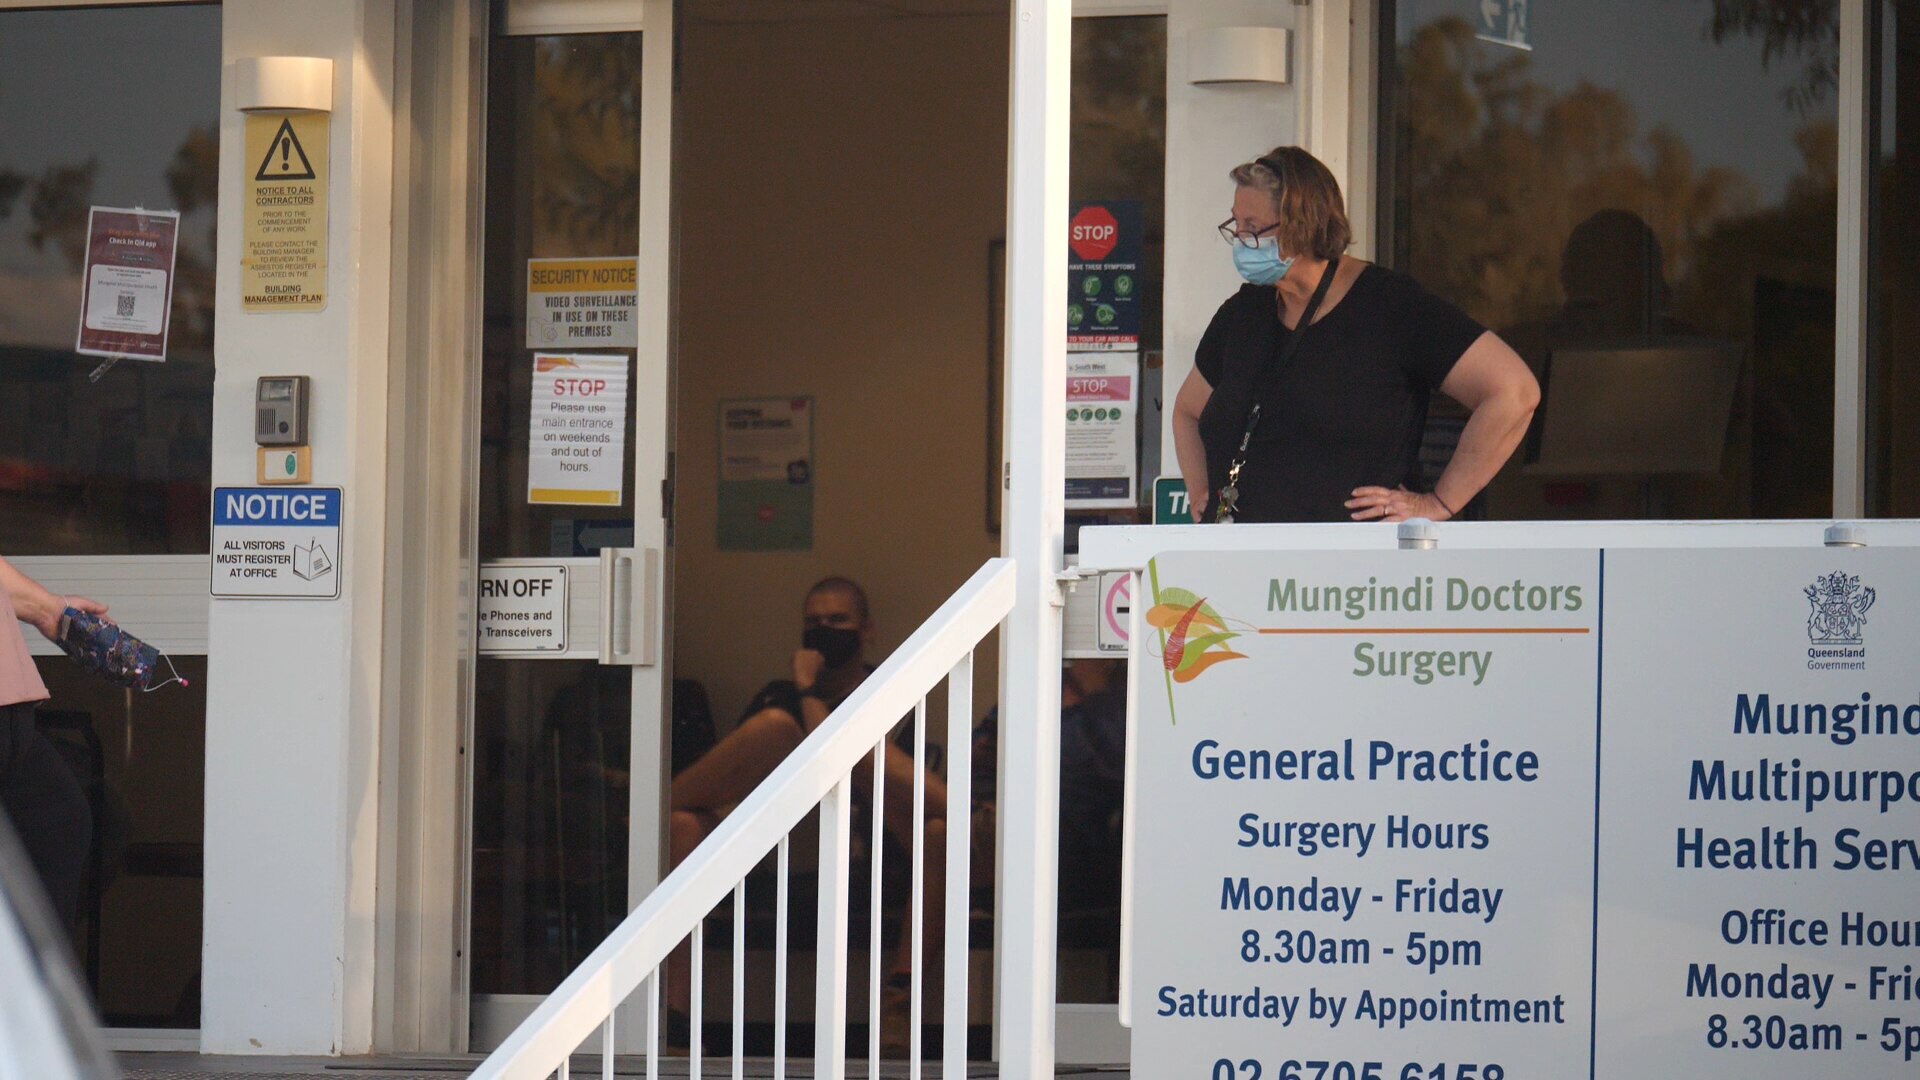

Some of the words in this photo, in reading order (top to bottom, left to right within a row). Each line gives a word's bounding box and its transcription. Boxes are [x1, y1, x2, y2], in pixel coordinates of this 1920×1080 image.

[256, 187, 285, 196] NOTICE
[287, 187, 297, 195] TO
[299, 186, 314, 194] ALL
[256, 196, 314, 205] CONTRACTORS
[257, 218, 311, 226] COMMENCEMENT
[1073, 225, 1114, 240] STOP
[109, 236, 127, 246] Check
[1069, 263, 1083, 271] HAVE
[1085, 263, 1103, 271] THESE
[1103, 263, 1136, 271] SYMPTOMS
[532, 269, 589, 285] SECURITY
[592, 267, 636, 283] NOTICE
[264, 285, 302, 293] BUILDING
[244, 294, 299, 303] MANAGEMENT
[301, 294, 322, 303] PLAN
[545, 296, 570, 308] VIDEO
[573, 295, 637, 307] SURVEILLANCE
[552, 311, 562, 323] IN
[565, 311, 582, 322] USE
[585, 310, 598, 322] ON
[601, 310, 628, 321] THESE
[568, 325, 612, 337] PREMISES
[553, 378, 607, 396] STOP
[1072, 379, 1108, 393] STOP
[550, 402, 585, 413] Please
[588, 404, 606, 413] use
[542, 417, 567, 428] main
[569, 418, 614, 429] entrance
[543, 433, 556, 442] on
[559, 432, 610, 443] weekends
[551, 447, 570, 457] and
[573, 448, 589, 457] out
[592, 447, 603, 457] of
[560, 460, 592, 472] hours.
[226, 494, 326, 520] NOTICE
[223, 540, 241, 550] ALL
[243, 540, 285, 550] VISITORS
[216, 554, 242, 564] MUST
[244, 554, 291, 564] REGISTER
[229, 568, 242, 578] AT
[243, 568, 277, 578] OFFICE
[513, 579, 553, 597] OFF
[1266, 576, 1433, 620] Mungindi
[1446, 578, 1583, 612] Doctors
[490, 610, 530, 621] Phones
[533, 610, 552, 620] and
[486, 627, 553, 638] Transceivers
[1807, 647, 1865, 659] Queensland
[1352, 642, 1493, 686] Surgery
[1807, 660, 1865, 670] Government
[1191, 738, 1354, 781] General
[1367, 739, 1540, 782] Practice
[1237, 812, 1376, 858] Surgery
[1386, 815, 1490, 850] Hours
[1676, 825, 1817, 870] Health
[1220, 876, 1362, 922] Monday
[1395, 877, 1503, 923] Friday
[1721, 908, 1829, 946] Office
[1240, 928, 1370, 964] 8.30am
[1406, 931, 1482, 975] 5pm
[1686, 962, 1834, 1010] Monday
[1844, 982, 1857, 990] -
[1869, 964, 1920, 1001] Fri
[1157, 985, 1300, 1028] Saturday
[1309, 986, 1347, 1028] by
[1355, 989, 1565, 1029] Appointment
[1707, 1013, 1842, 1050] 8.30am
[1856, 1033, 1867, 1041] -
